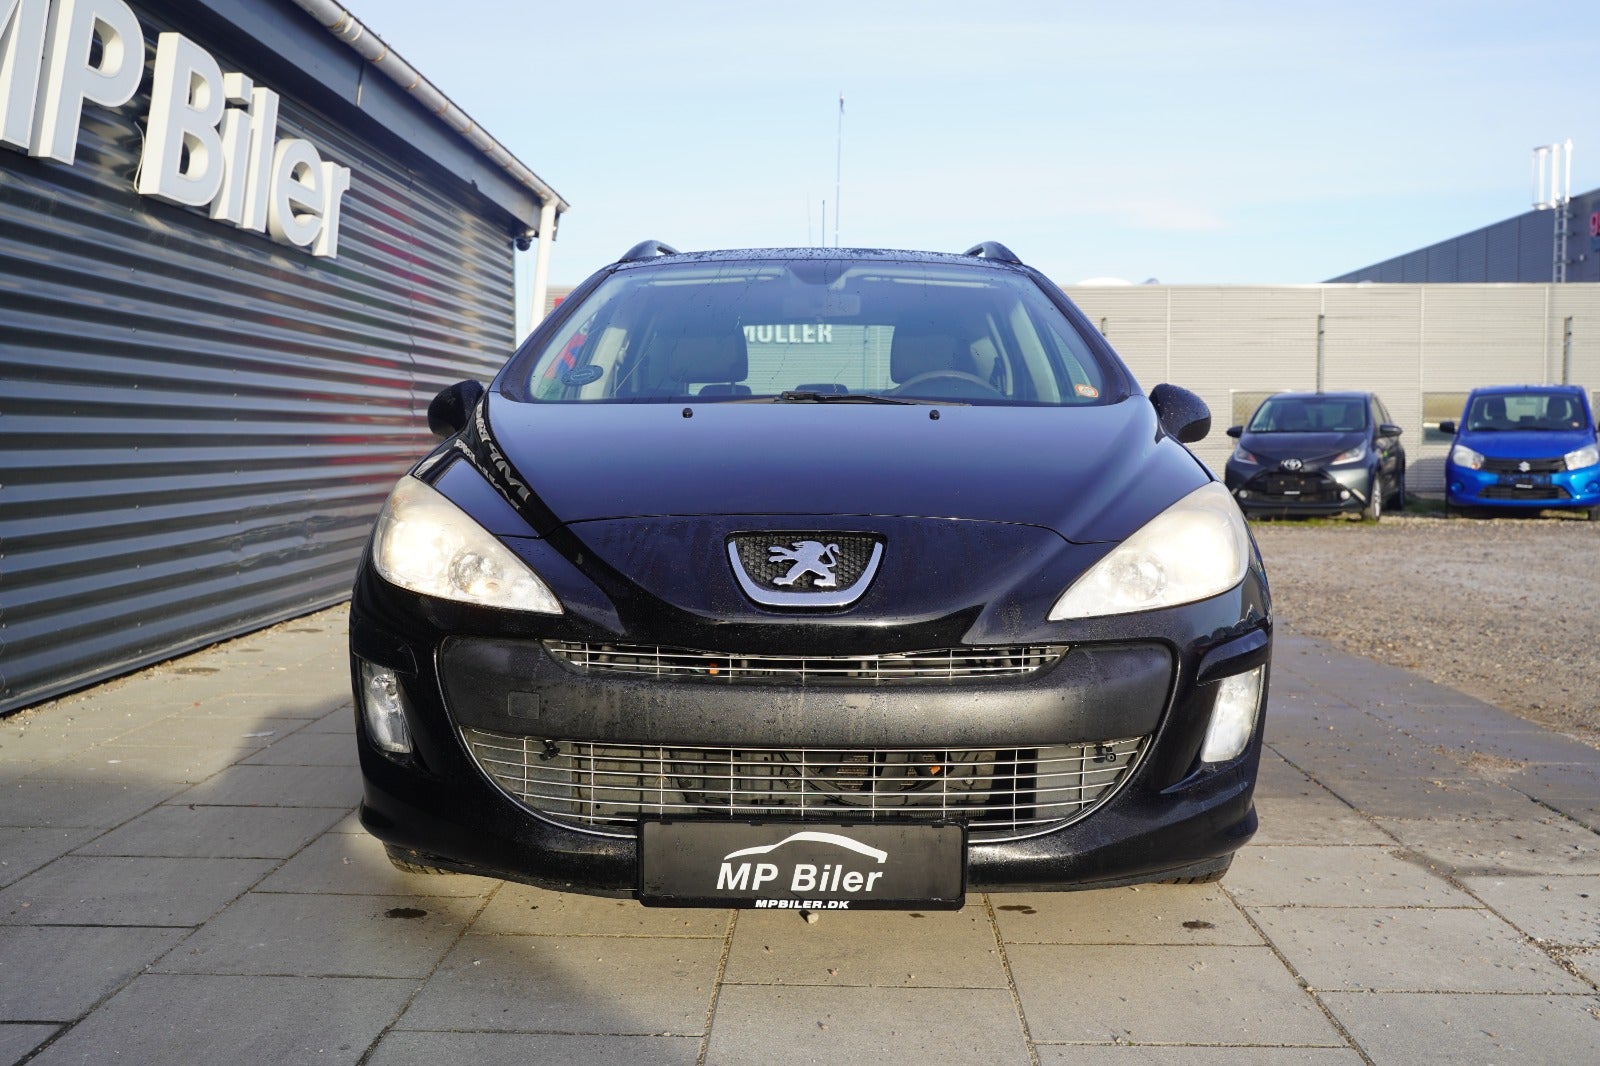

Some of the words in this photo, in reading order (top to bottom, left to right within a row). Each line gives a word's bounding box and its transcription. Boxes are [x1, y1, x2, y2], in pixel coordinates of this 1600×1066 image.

[139, 32, 350, 258] Biler
[716, 862, 778, 890] MP
[790, 863, 883, 892] Biler
[755, 899, 850, 910] MPBILER.DK
